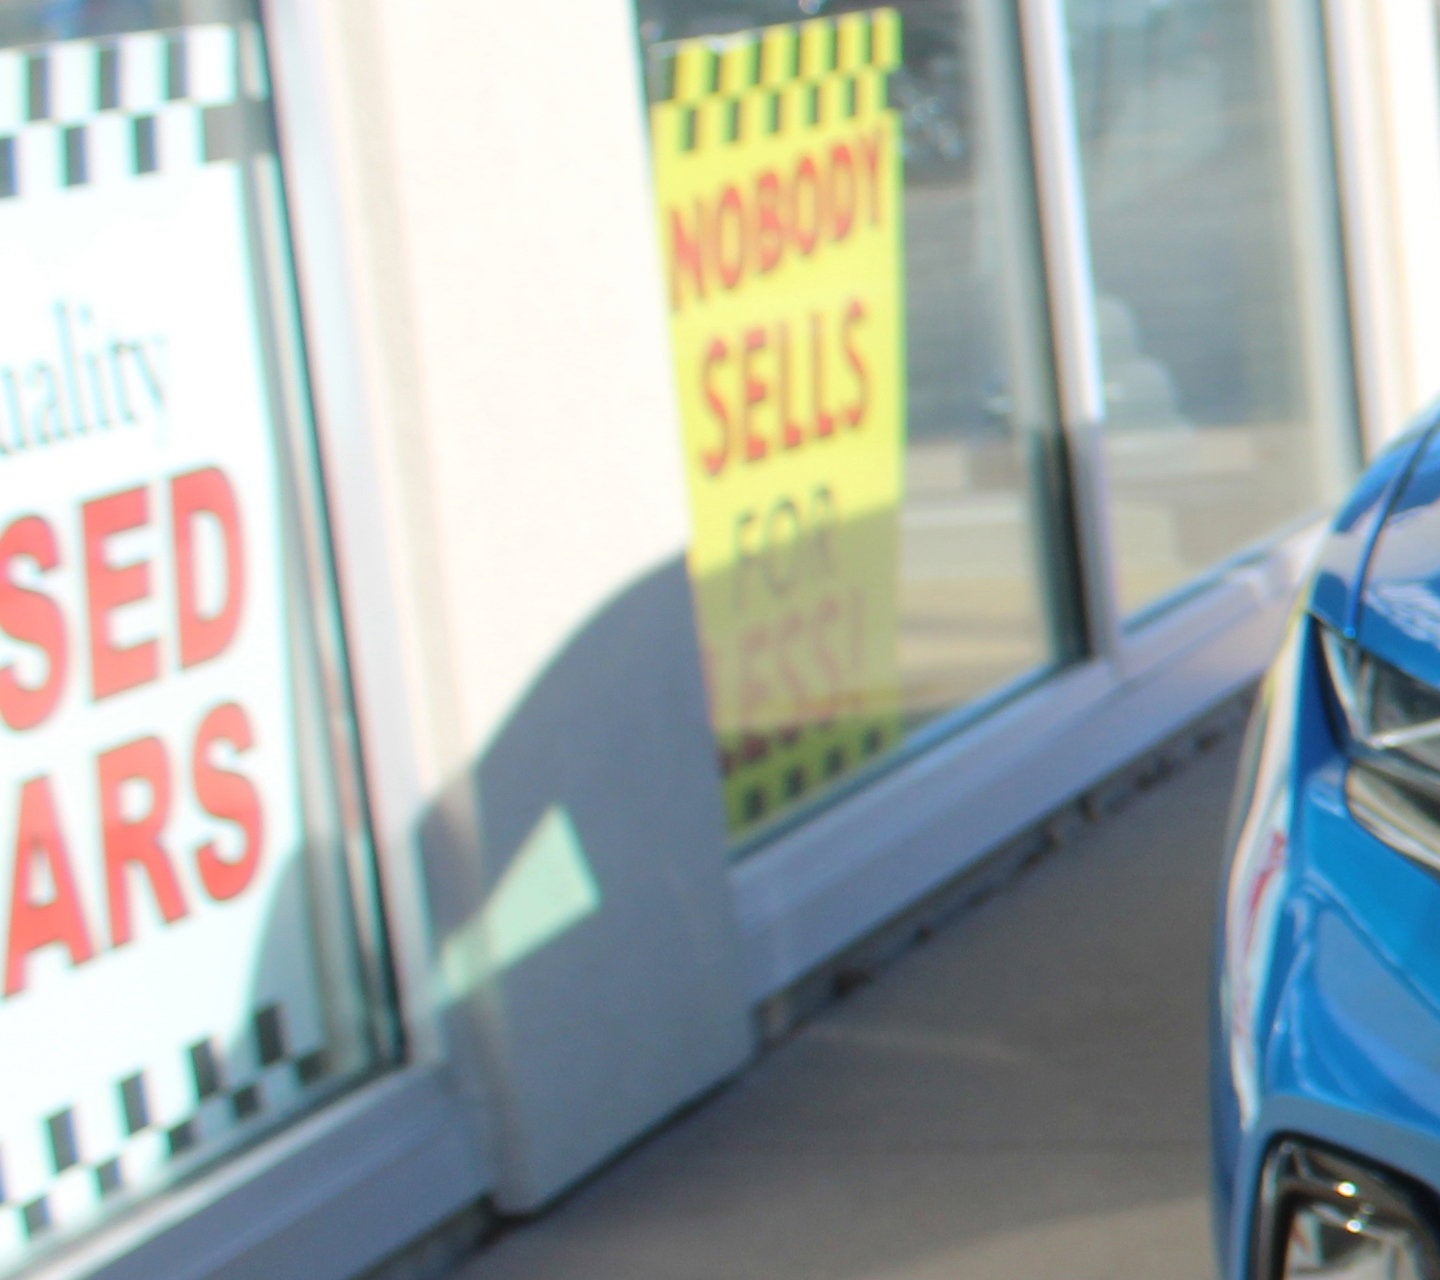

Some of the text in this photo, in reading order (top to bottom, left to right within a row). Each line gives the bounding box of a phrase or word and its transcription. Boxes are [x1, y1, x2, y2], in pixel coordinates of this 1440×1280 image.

[669, 128, 884, 315] NOBODY
[698, 298, 870, 478] SELLS
[733, 484, 838, 612] FOR
